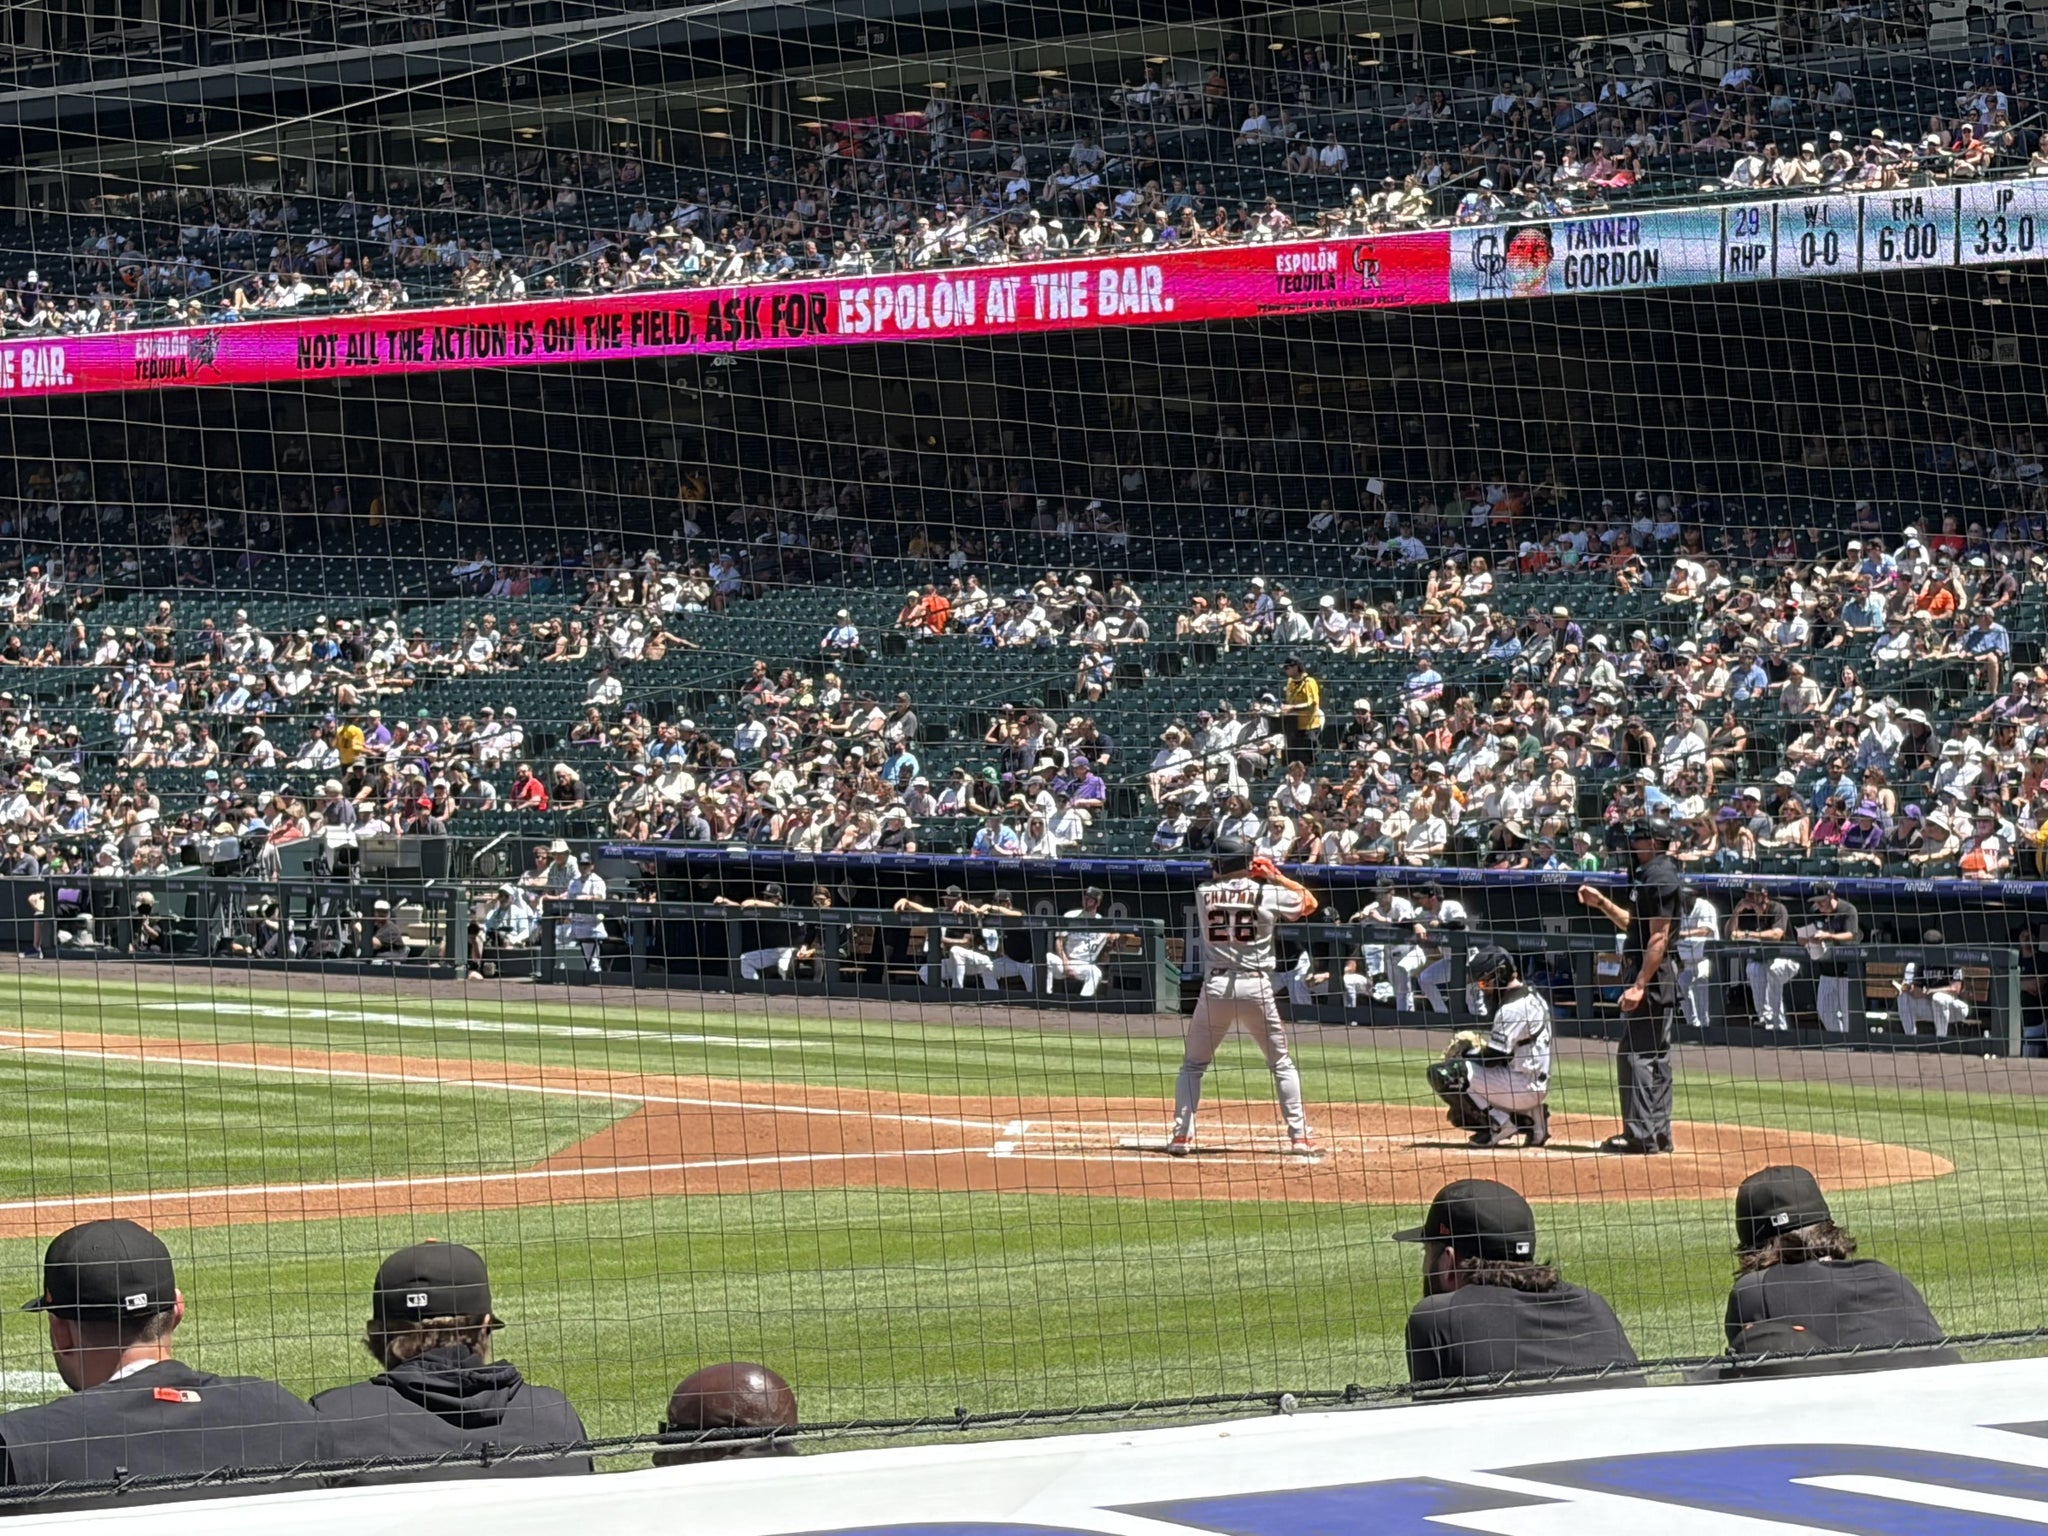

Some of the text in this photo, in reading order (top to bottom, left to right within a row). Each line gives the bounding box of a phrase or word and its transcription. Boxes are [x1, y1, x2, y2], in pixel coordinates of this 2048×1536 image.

[1892, 196, 1924, 221] ERA
[1996, 189, 2014, 212] IP
[1564, 216, 1641, 251] TANNER
[1735, 207, 1759, 237] 29
[1974, 216, 2034, 255] 33.0
[1800, 229, 1840, 268] 0-0
[1879, 223, 1937, 262] 6.00
[1564, 248, 1659, 289] GORDON
[1730, 244, 1766, 272] RHP
[1276, 272, 1337, 295] TEQUILA
[296, 333, 339, 370] NOT
[345, 330, 380, 366] ALL
[386, 327, 425, 363] THE
[430, 321, 507, 362] ACTION
[514, 320, 536, 357] IS
[543, 316, 575, 354] ON
[583, 313, 622, 351] THE
[631, 308, 698, 348] FIELD.
[704, 295, 762, 343] ASK
[771, 291, 829, 339] FOR
[984, 276, 1020, 324] AT
[1031, 271, 1090, 321] THE
[1098, 264, 1175, 317] BAR.
[21, 345, 74, 389] BAR.
[136, 357, 188, 381] TEQUILA
[1904, 881, 1934, 892] ARROW
[2001, 883, 2034, 895] ARROW
